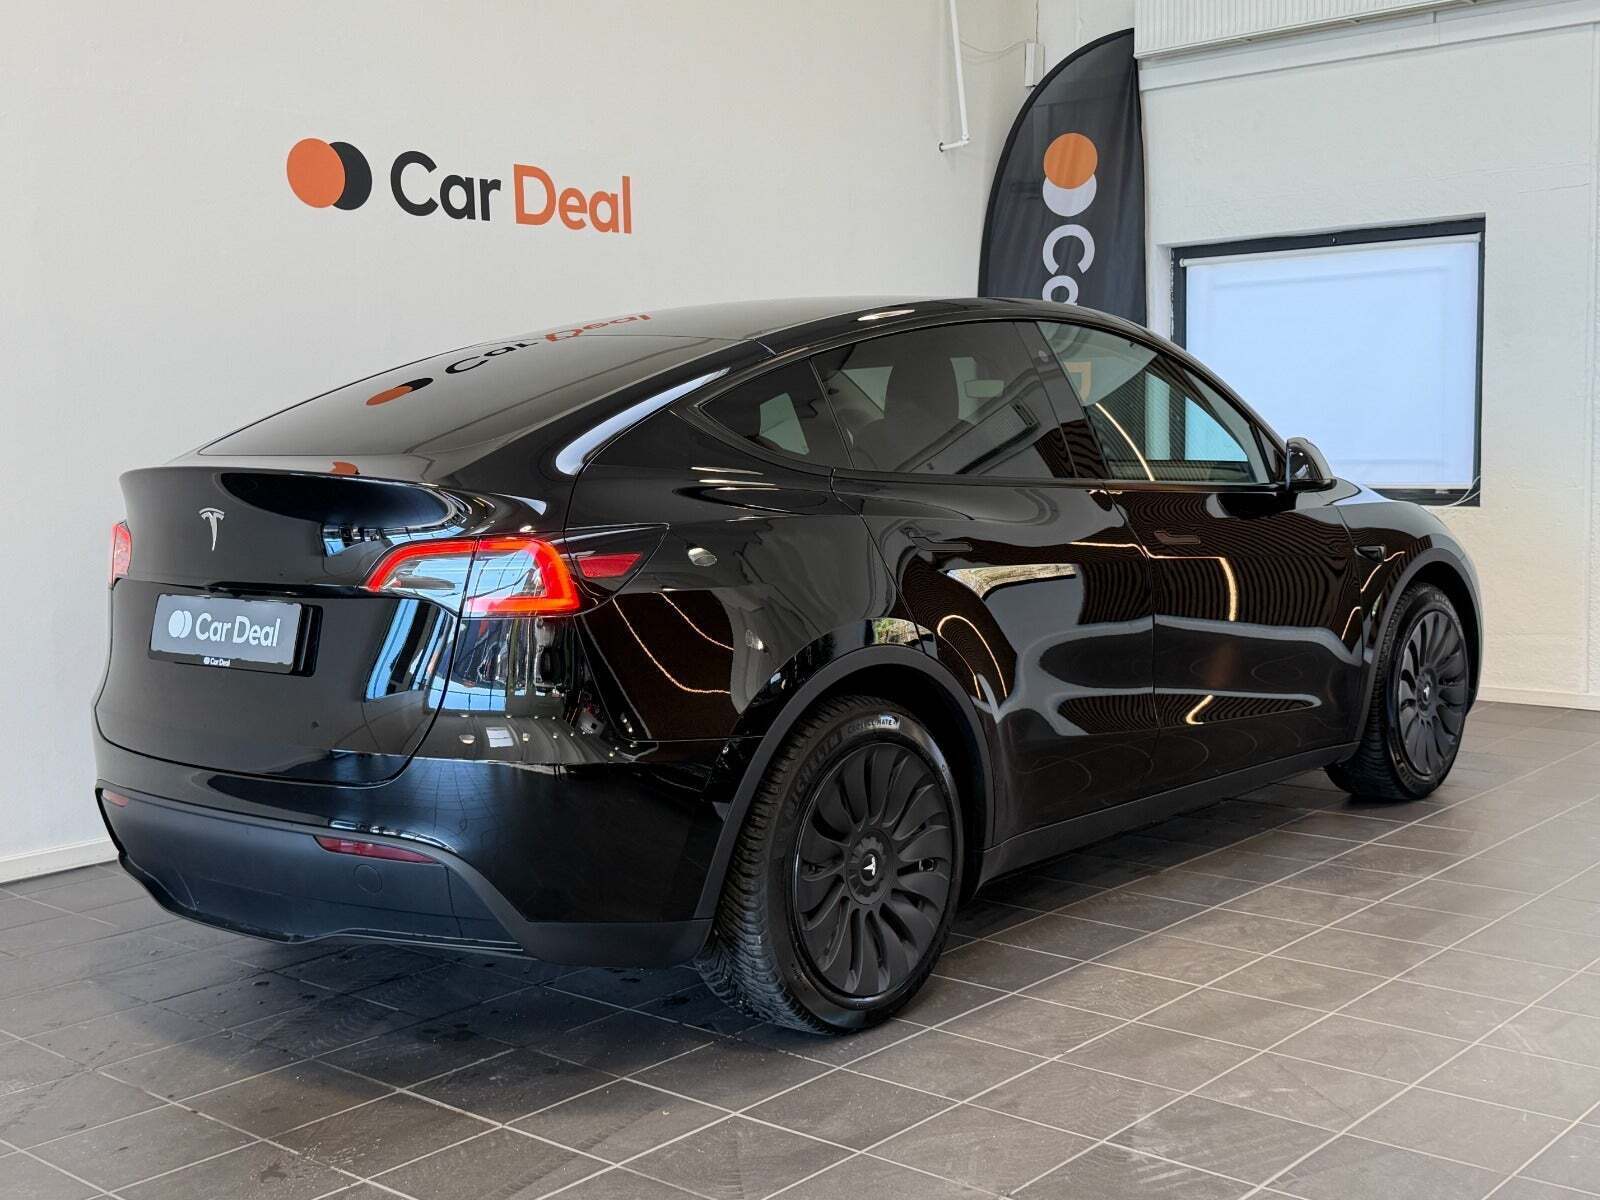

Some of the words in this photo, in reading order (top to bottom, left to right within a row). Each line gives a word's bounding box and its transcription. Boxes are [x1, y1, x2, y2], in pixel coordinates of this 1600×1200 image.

[390, 150, 502, 222] Car
[513, 163, 633, 235] Deal
[195, 612, 232, 643] Car
[232, 615, 281, 647] Deal
